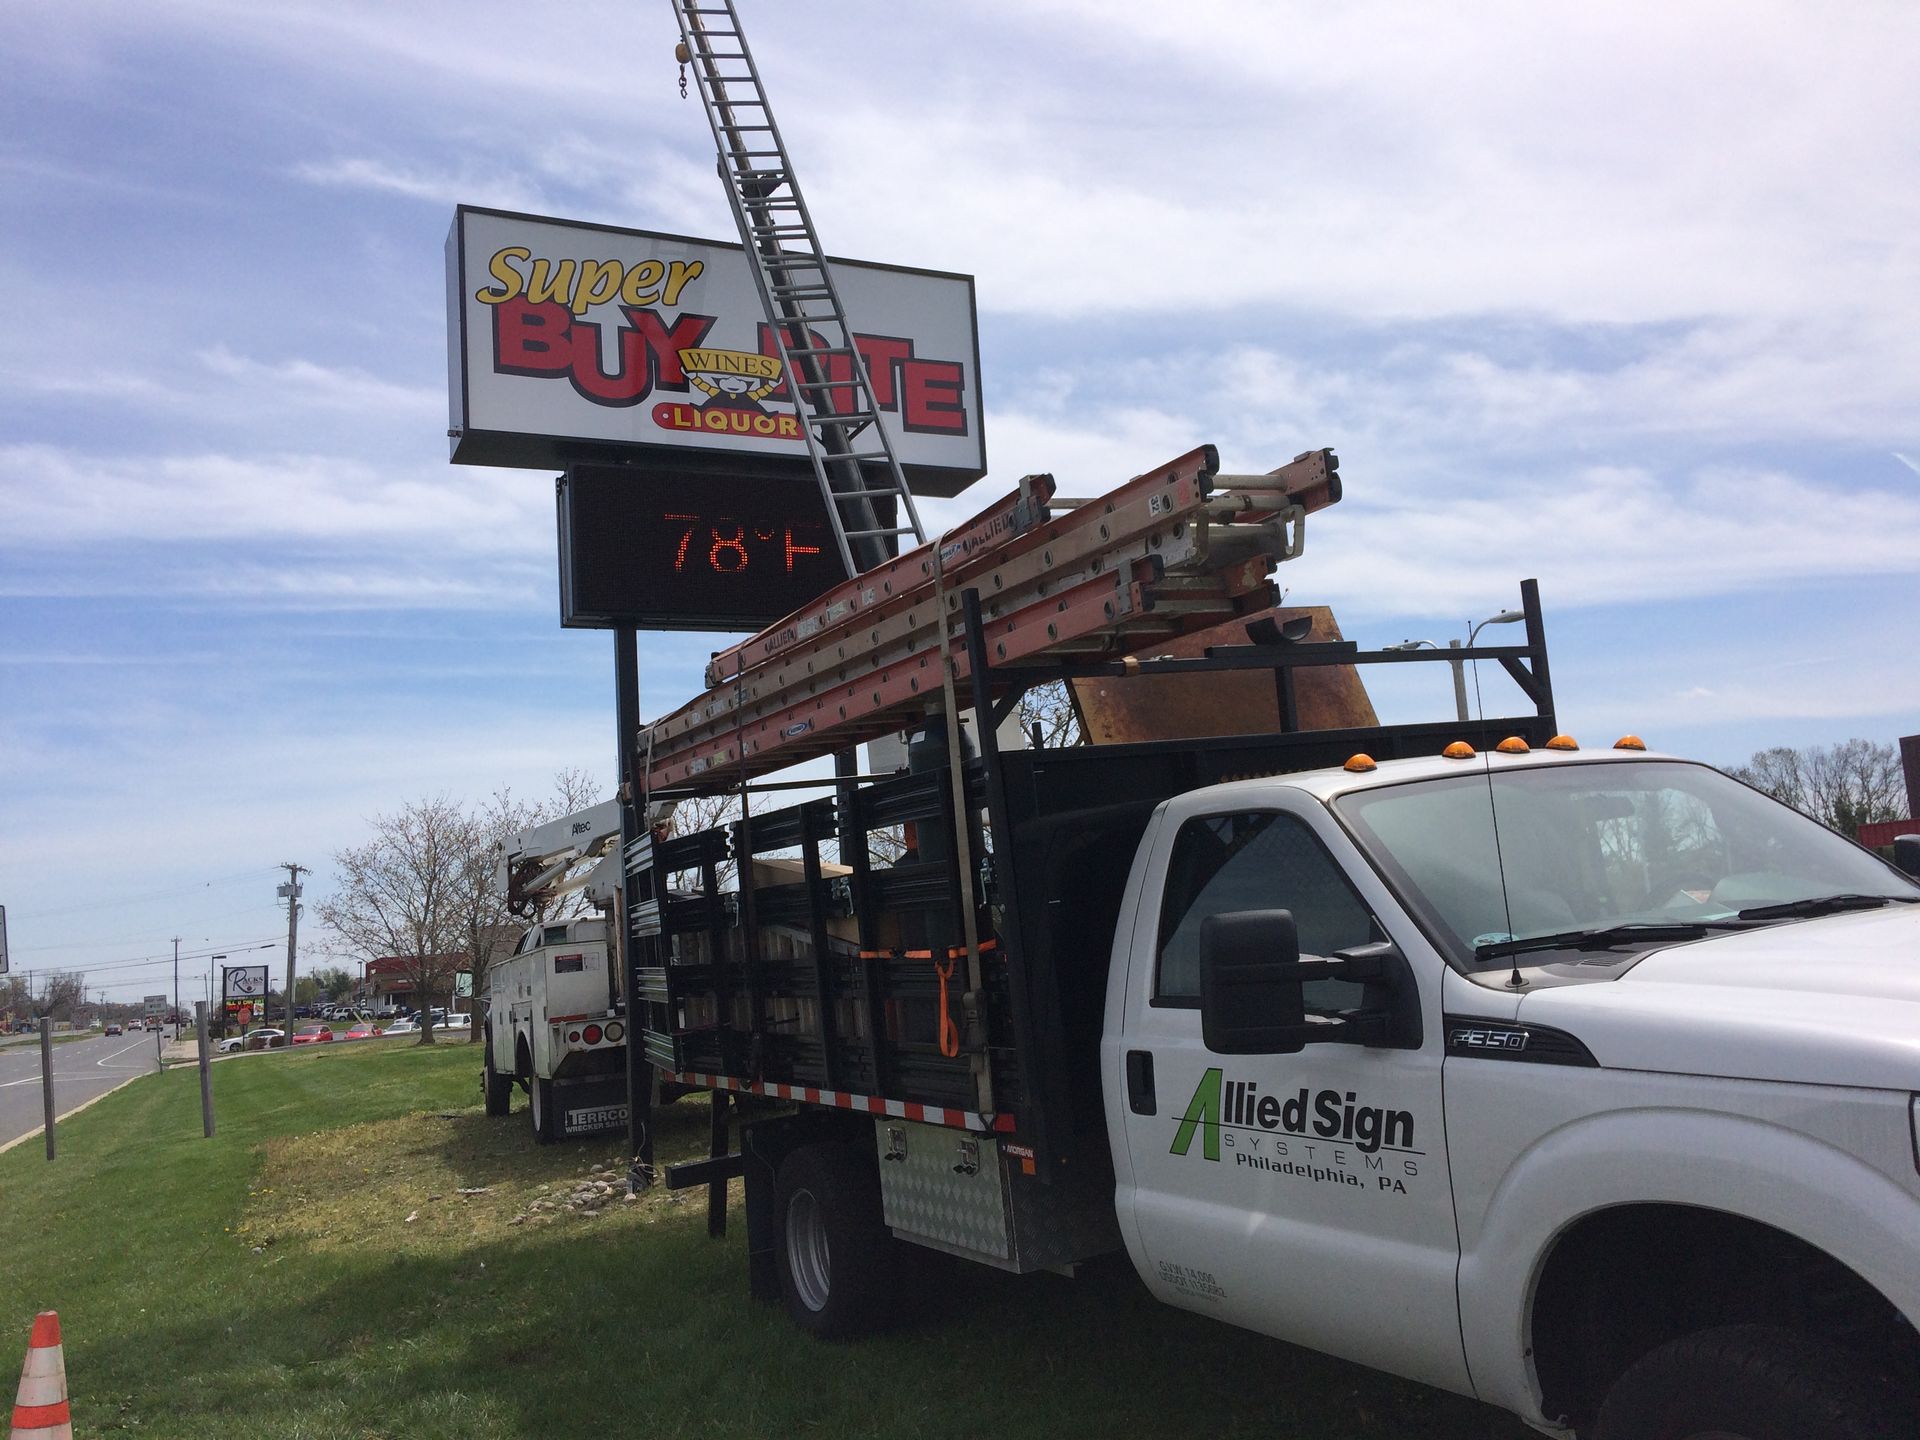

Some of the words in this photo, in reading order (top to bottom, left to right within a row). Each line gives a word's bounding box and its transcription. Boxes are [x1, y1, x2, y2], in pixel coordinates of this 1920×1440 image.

[475, 246, 705, 315] Super
[491, 289, 718, 409] BUY
[687, 351, 774, 378] WINES
[571, 820, 592, 837] Altec
[565, 1122, 604, 1134] WRECKER
[568, 1104, 628, 1125] TERRCO
[1169, 1067, 1310, 1163] Allied
[1311, 1088, 1415, 1154] Sign
[1223, 1132, 1420, 1177] SYSTEMS
[1235, 1152, 1366, 1190] Philadelphia,
[1377, 1175, 1408, 1195] PA
